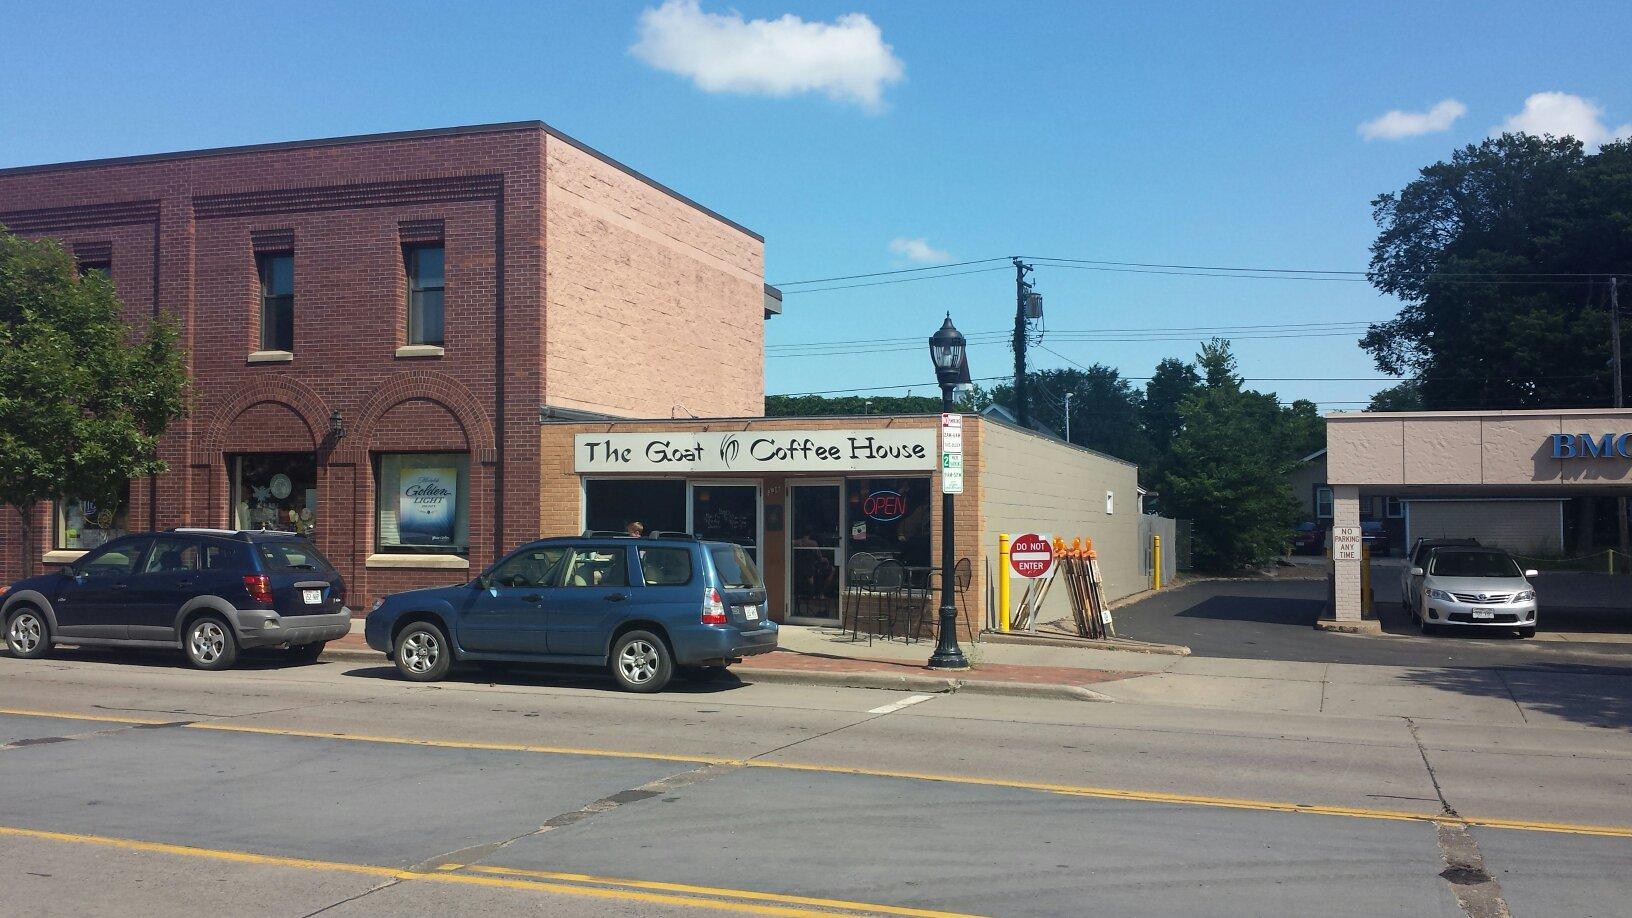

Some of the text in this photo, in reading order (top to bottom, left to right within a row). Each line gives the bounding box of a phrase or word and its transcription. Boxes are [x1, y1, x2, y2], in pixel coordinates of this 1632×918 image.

[584, 437, 926, 463] The Goat Coffee House
[943, 455, 949, 467] 2
[406, 484, 452, 496] Golden
[863, 496, 906, 515] OPEN
[1016, 542, 1046, 551] DO NOT
[1019, 562, 1044, 570] ENTER
